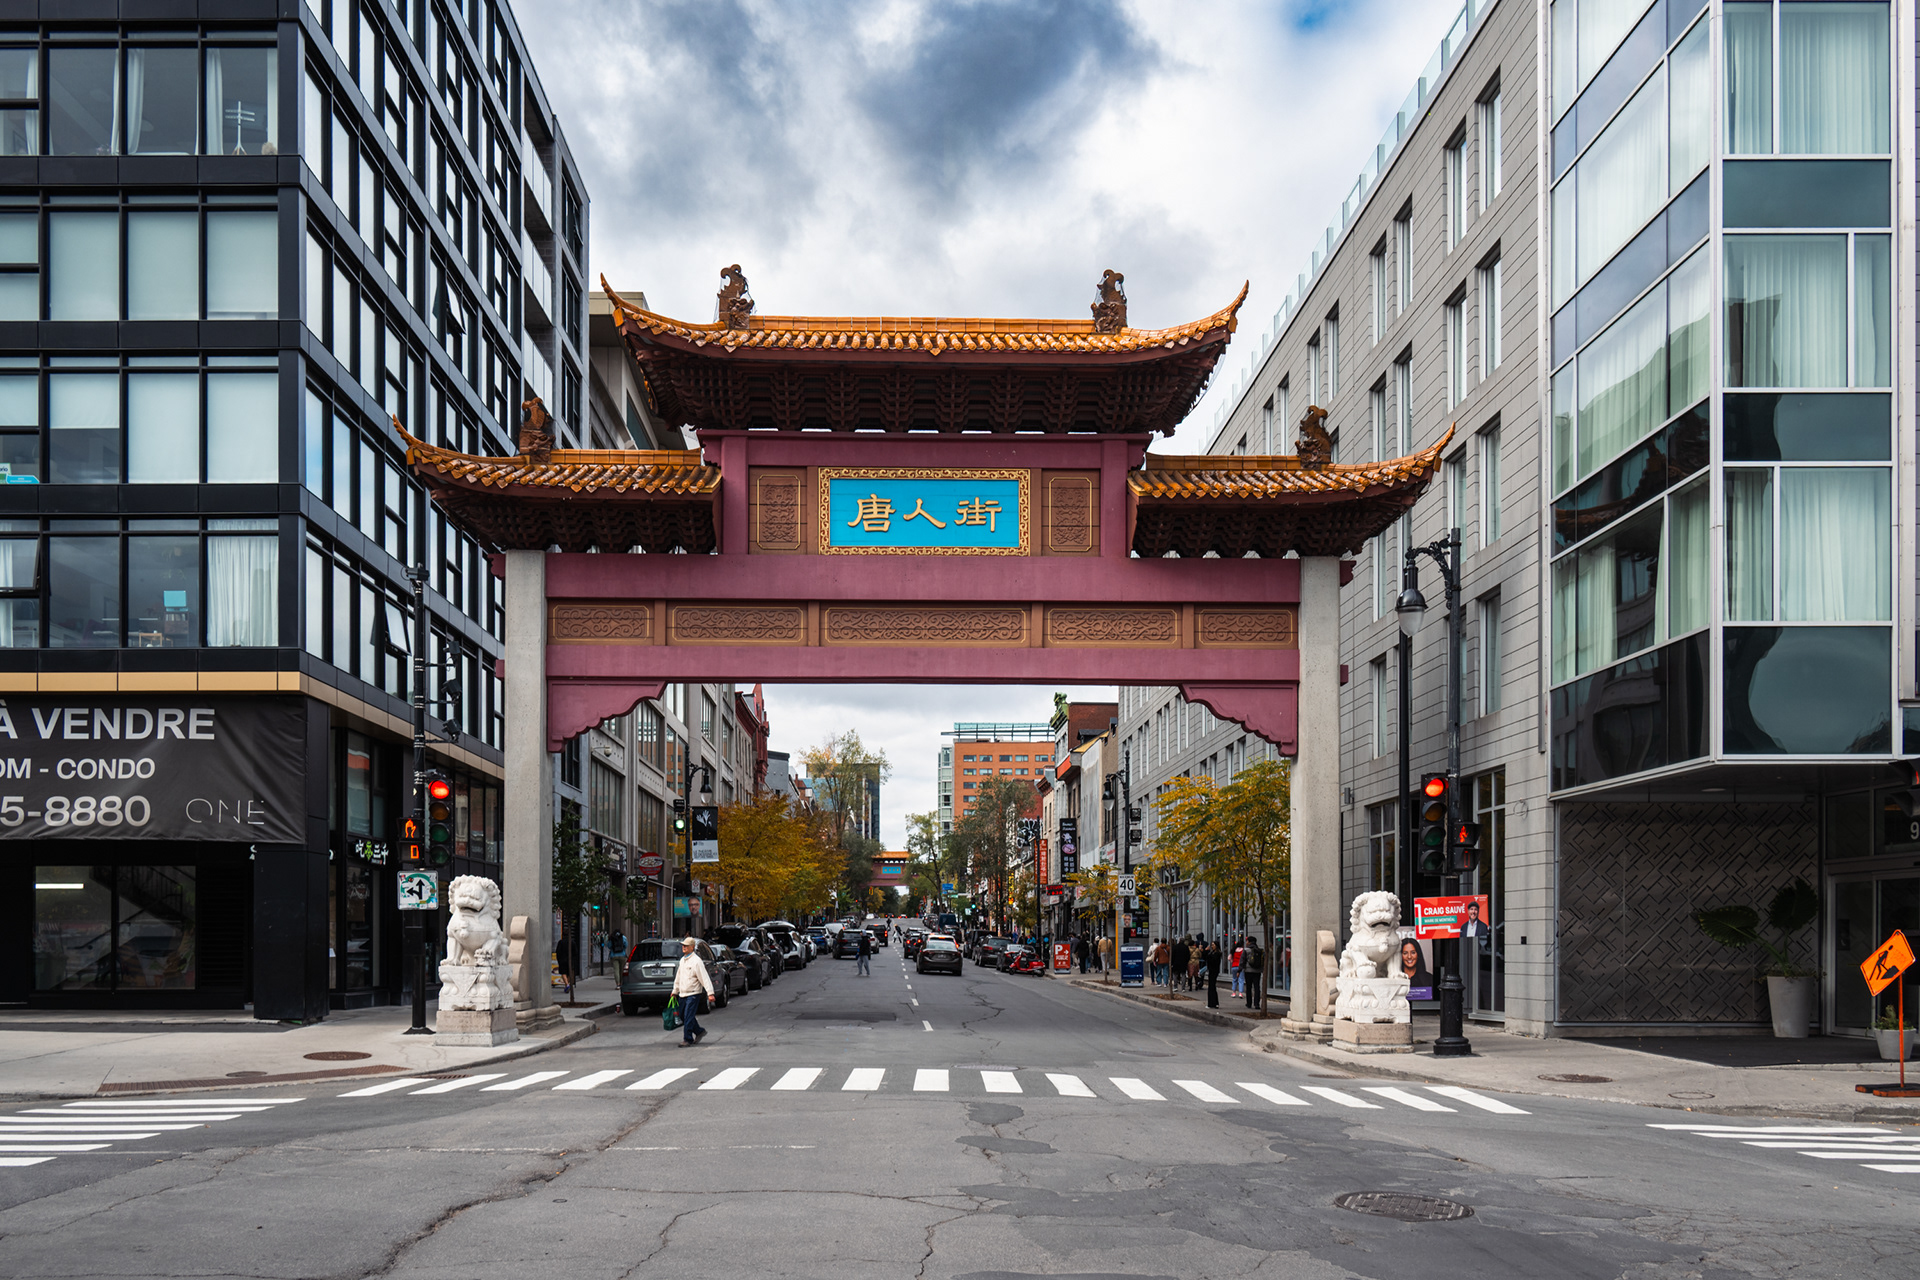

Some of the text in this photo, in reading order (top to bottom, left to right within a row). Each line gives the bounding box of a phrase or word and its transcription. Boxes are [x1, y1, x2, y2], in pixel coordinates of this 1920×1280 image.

[847, 493, 1002, 532] 唐人街
[31, 708, 215, 740] VENDRE
[56, 757, 156, 780] CONDO
[0, 795, 151, 827] 5-8880
[186, 798, 264, 825] ONE
[1119, 878, 1134, 891] 40
[1424, 903, 1465, 915] CRAIG SAUVÉ
[1054, 944, 1063, 955] P
